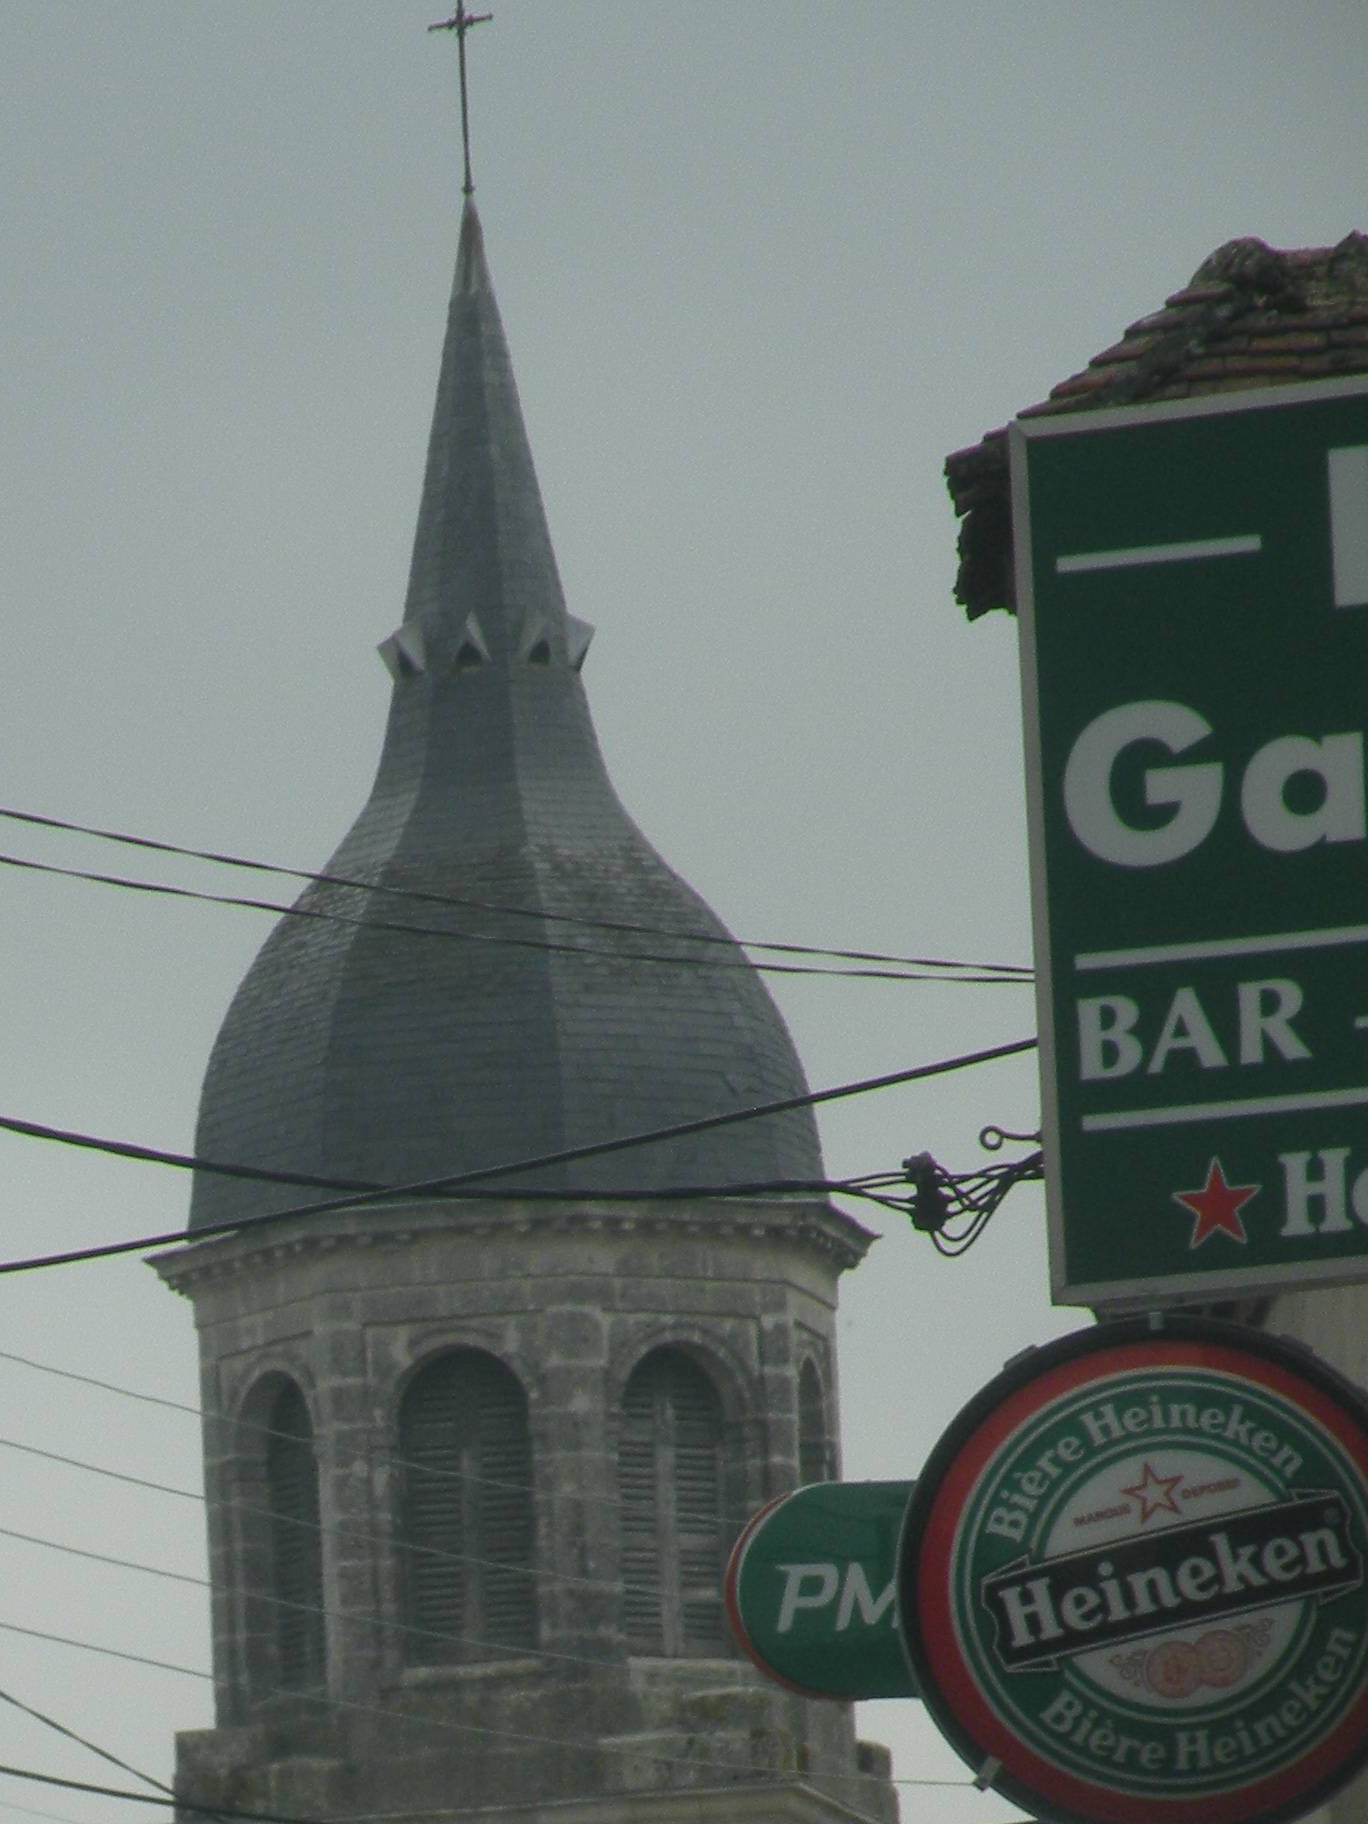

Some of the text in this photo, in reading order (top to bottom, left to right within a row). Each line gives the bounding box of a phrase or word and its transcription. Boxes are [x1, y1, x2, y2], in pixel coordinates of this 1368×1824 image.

[1078, 978, 1313, 1082] BAR
[1278, 1147, 1368, 1236] H
[985, 1395, 1306, 1544] Bière Heineken
[998, 1525, 1349, 1649] Heineken
[1038, 1627, 1358, 1771] Bière Heineken
